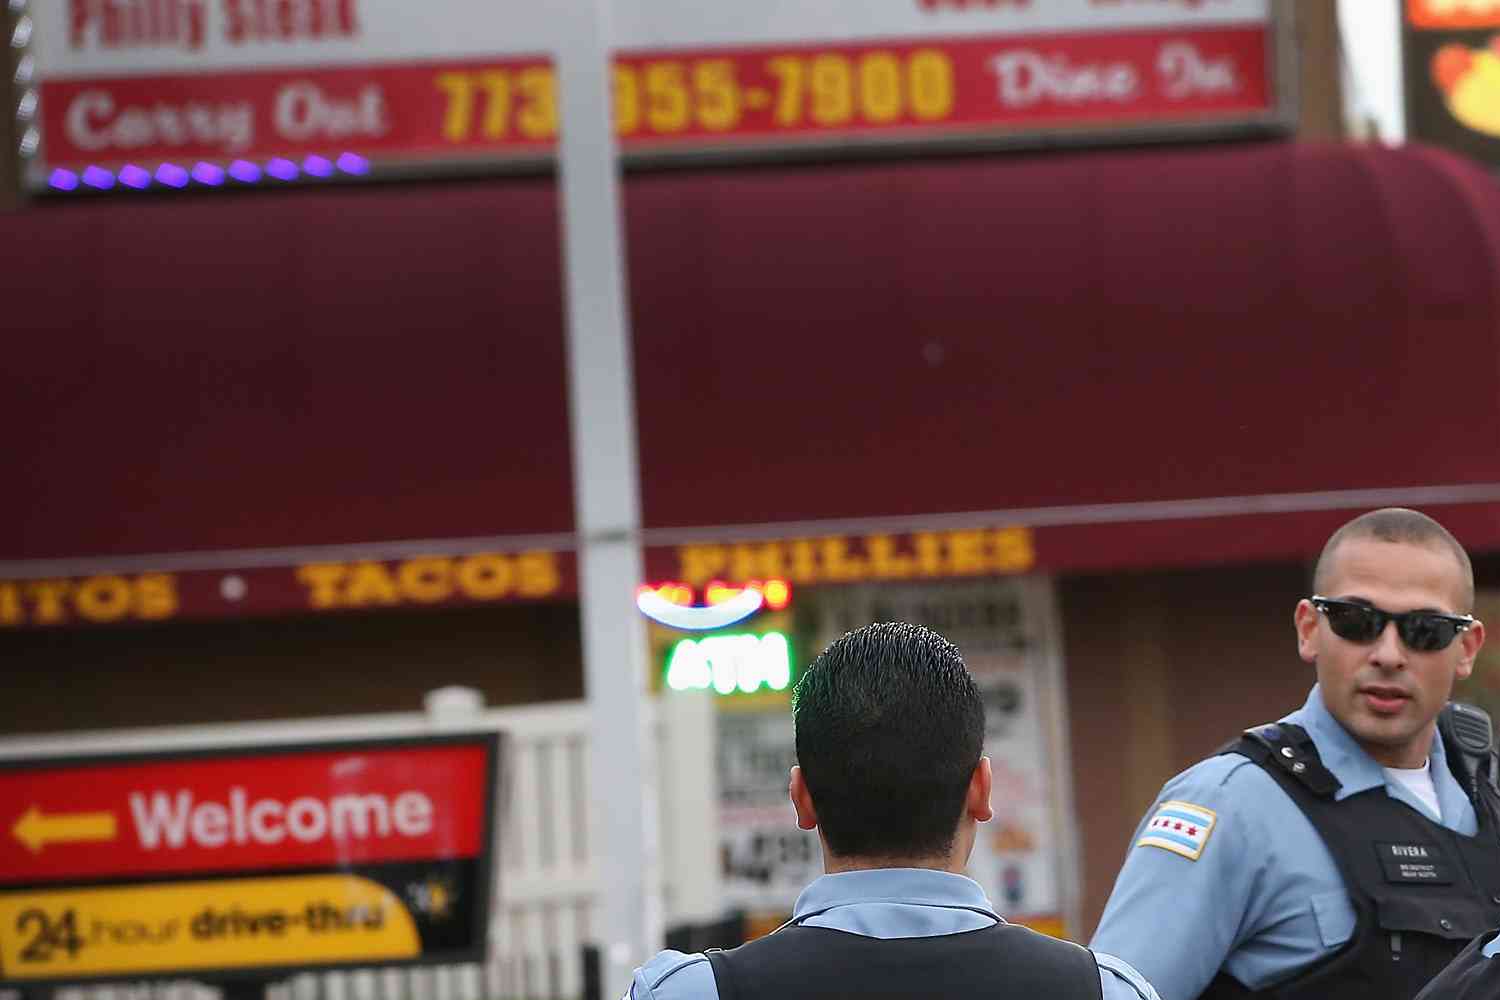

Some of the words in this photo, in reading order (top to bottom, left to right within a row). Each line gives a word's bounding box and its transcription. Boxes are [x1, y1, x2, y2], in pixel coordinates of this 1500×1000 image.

[273, 81, 389, 139] Out
[297, 548, 562, 610] TACOS
[680, 525, 1035, 587] PHILLIES
[129, 786, 434, 852] Welcome
[15, 906, 84, 964] 24
[88, 916, 180, 946] hour
[189, 901, 386, 942] drive-thru
